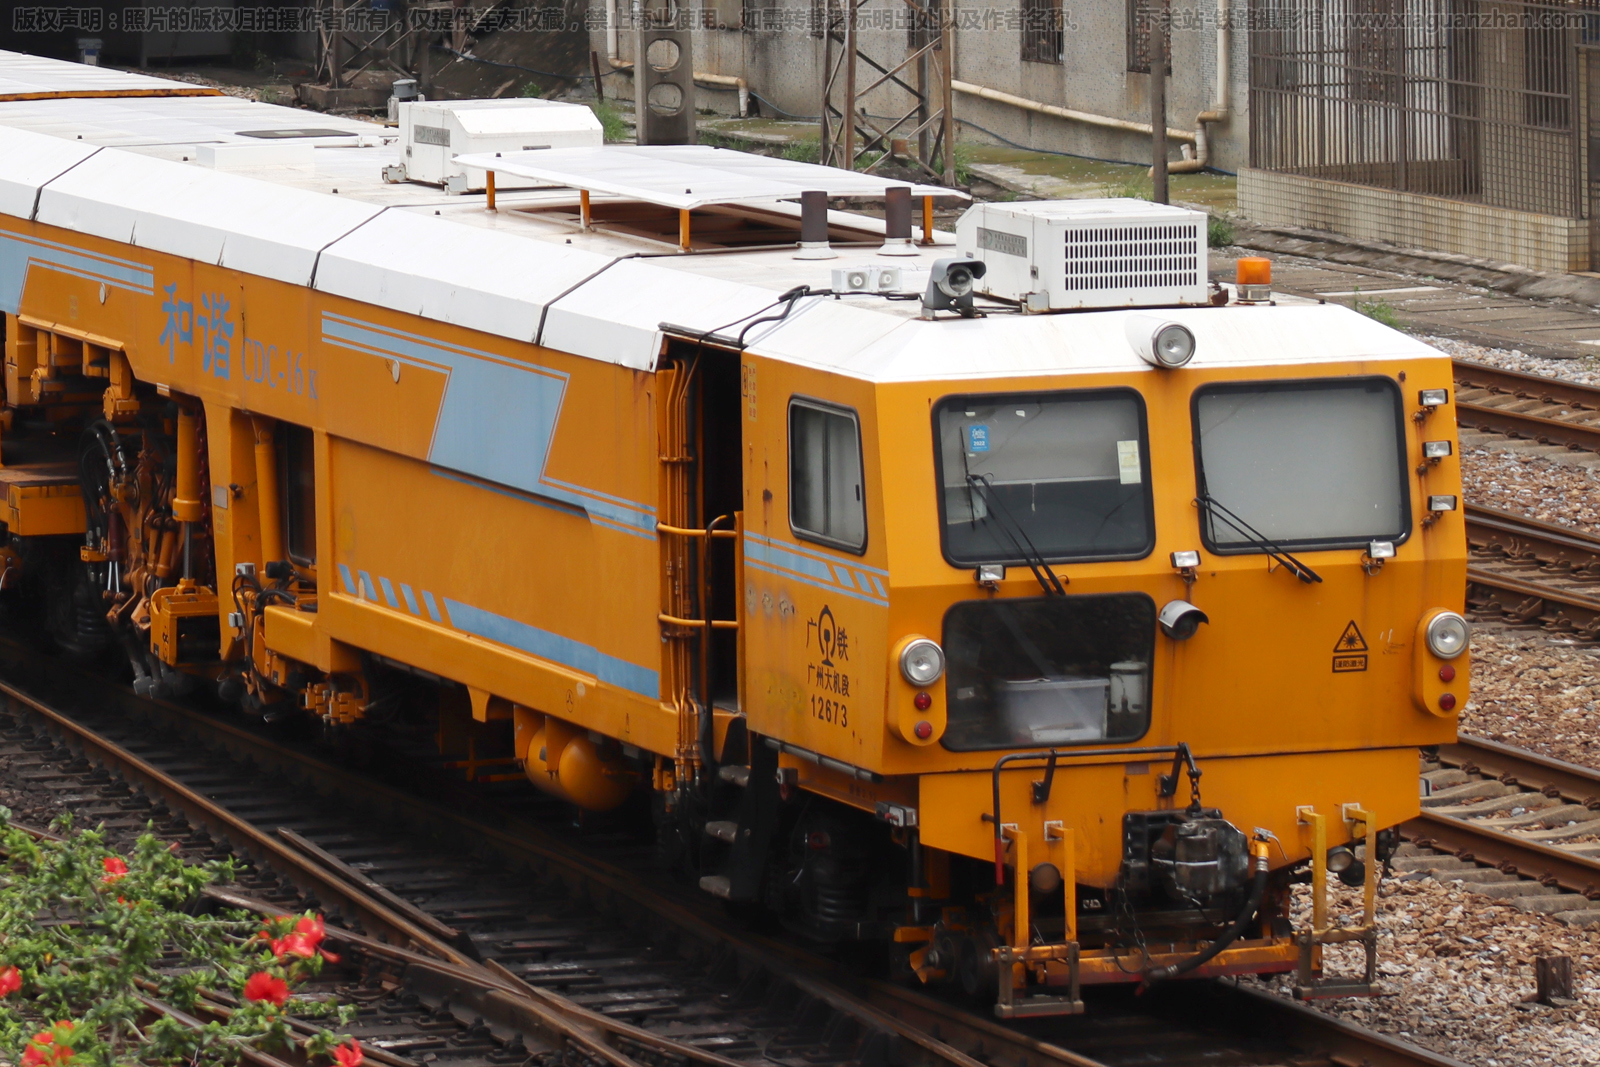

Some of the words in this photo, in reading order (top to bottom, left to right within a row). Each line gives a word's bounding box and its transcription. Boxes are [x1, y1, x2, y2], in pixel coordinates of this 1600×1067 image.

[159, 281, 235, 381] 和谐
[807, 662, 850, 697] 广州大机段
[811, 693, 848, 728] 12673
